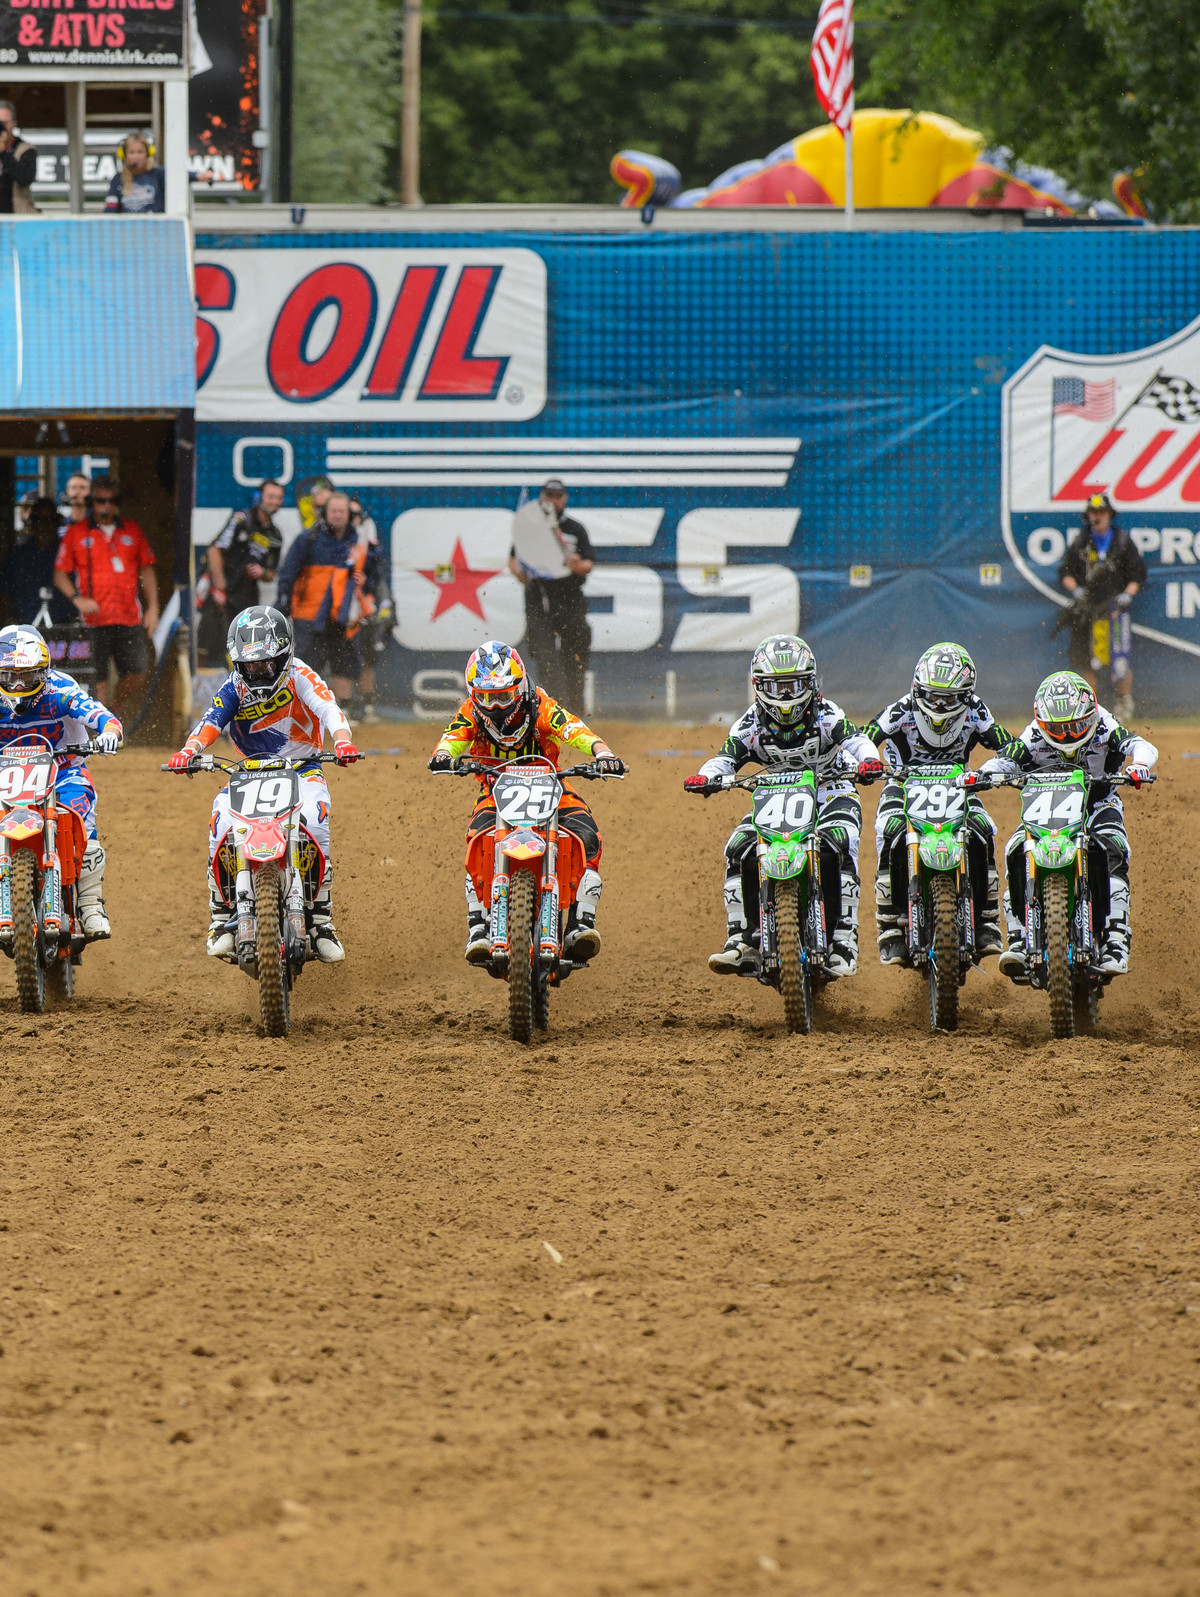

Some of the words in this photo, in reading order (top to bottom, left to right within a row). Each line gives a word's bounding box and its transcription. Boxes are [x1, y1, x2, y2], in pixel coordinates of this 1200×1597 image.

[17, 14, 44, 47] &
[50, 13, 126, 48] ATVS
[27, 49, 179, 65] www.denniskirk.com
[266, 262, 512, 403] OIL
[233, 687, 293, 721] GEICO
[236, 777, 292, 816] 19
[499, 784, 560, 820] 25
[754, 792, 814, 829] 40
[906, 784, 966, 819] 292
[1022, 791, 1085, 825] 44
